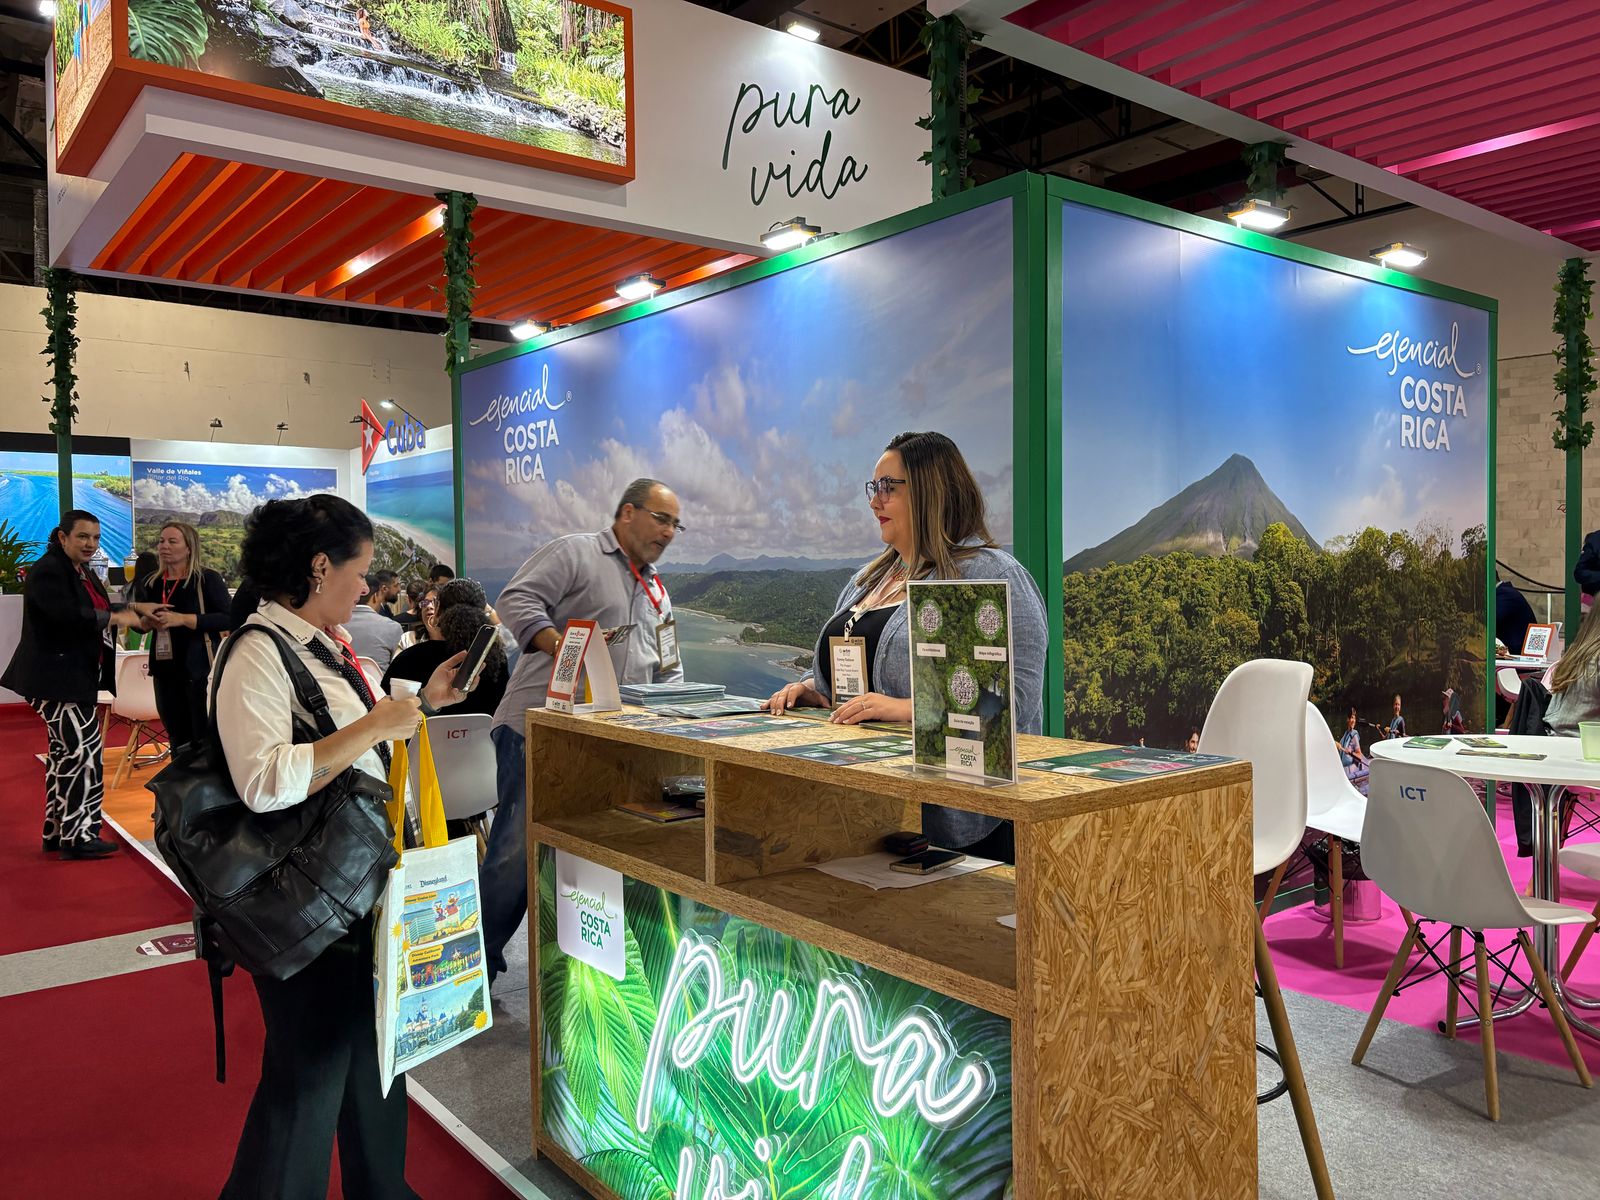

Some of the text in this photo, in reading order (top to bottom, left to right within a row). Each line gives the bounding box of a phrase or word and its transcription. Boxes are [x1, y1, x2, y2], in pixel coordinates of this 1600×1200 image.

[722, 83, 861, 170] pura
[751, 130, 868, 206] vida
[1347, 321, 1476, 377] esencial
[469, 363, 566, 432] esencial
[1400, 375, 1468, 417] COSTA
[385, 411, 426, 455] Cuba
[503, 418, 560, 454] COSTA
[1401, 414, 1451, 451] RICA
[505, 453, 545, 484] RICA
[447, 728, 469, 739] ICT
[960, 753, 977, 762] COSTA
[960, 760, 973, 768] RICA
[1399, 785, 1427, 802] ICT
[560, 891, 615, 919] esencial
[580, 910, 612, 938] COSTA
[581, 926, 604, 950] RICA
[636, 935, 986, 1134] pura
